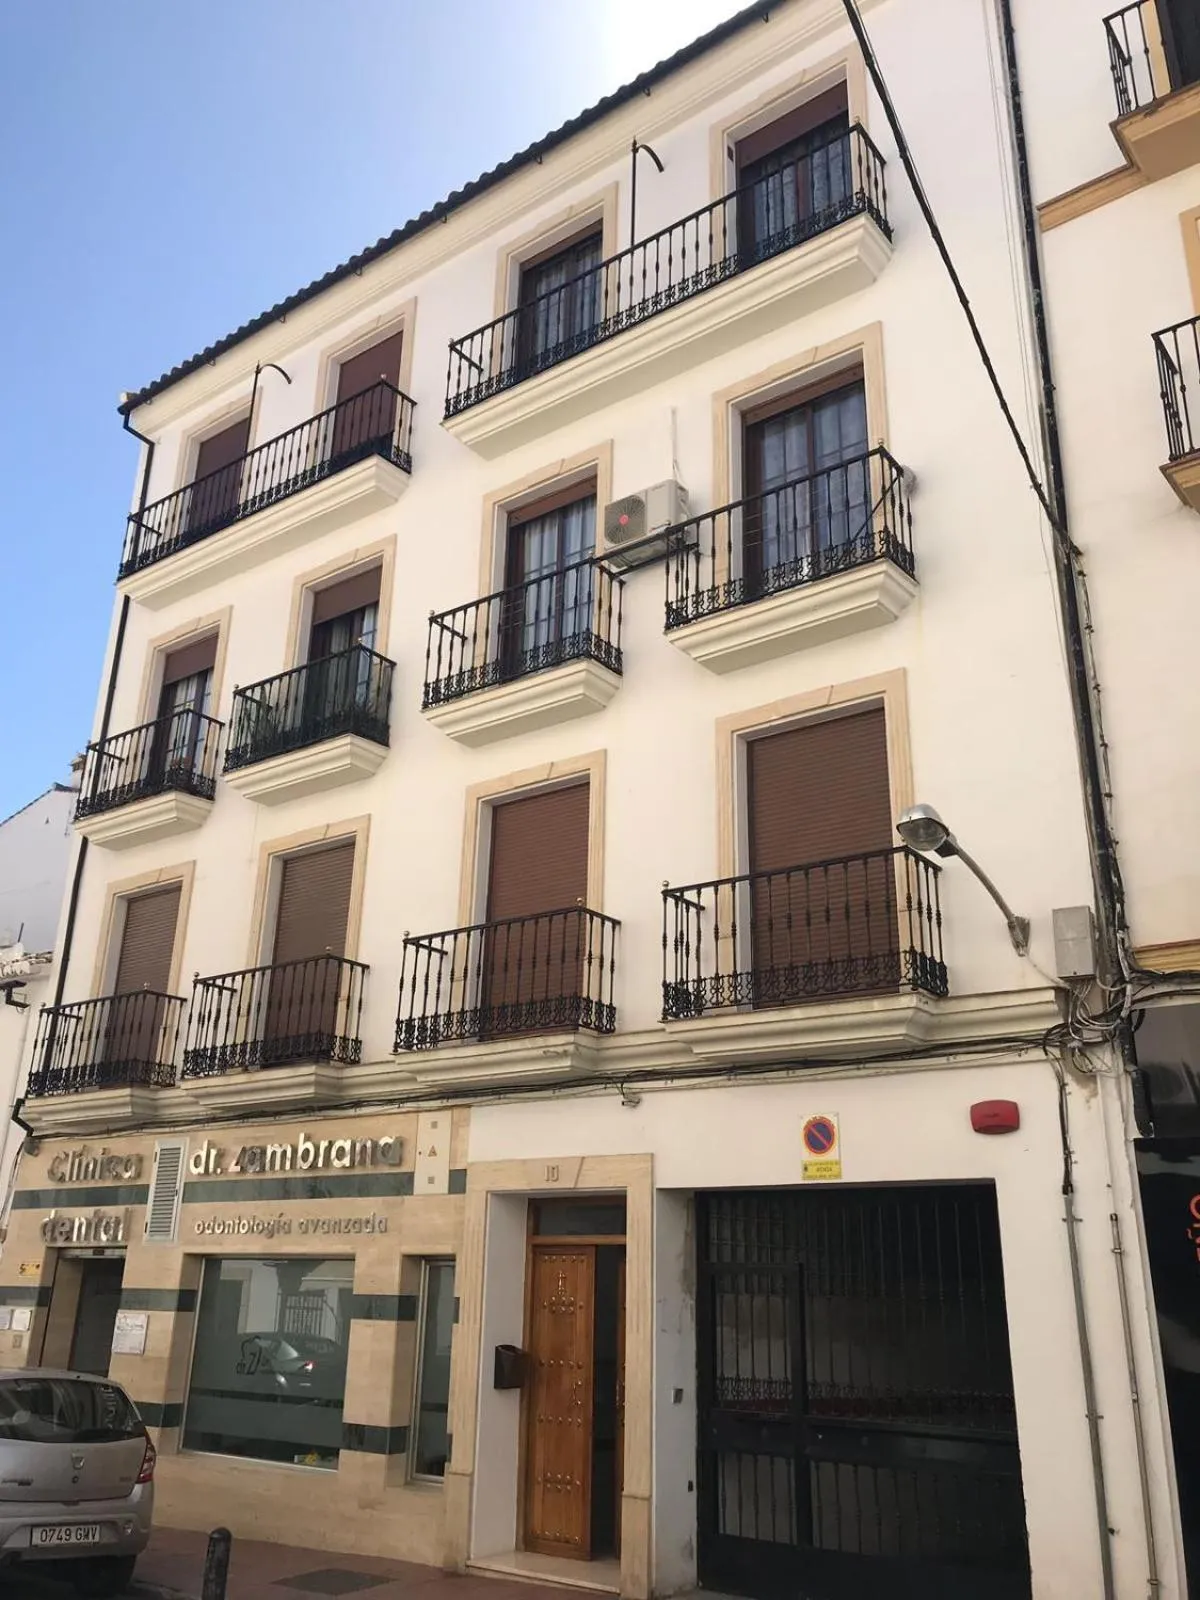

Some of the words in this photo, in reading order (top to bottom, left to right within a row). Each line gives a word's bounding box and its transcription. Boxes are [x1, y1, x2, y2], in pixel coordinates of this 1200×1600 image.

[41, 1208, 132, 1242] dental
[195, 1212, 292, 1238] odontología
[299, 1211, 388, 1235] avanzada
[40, 1528, 72, 1542] 0749
